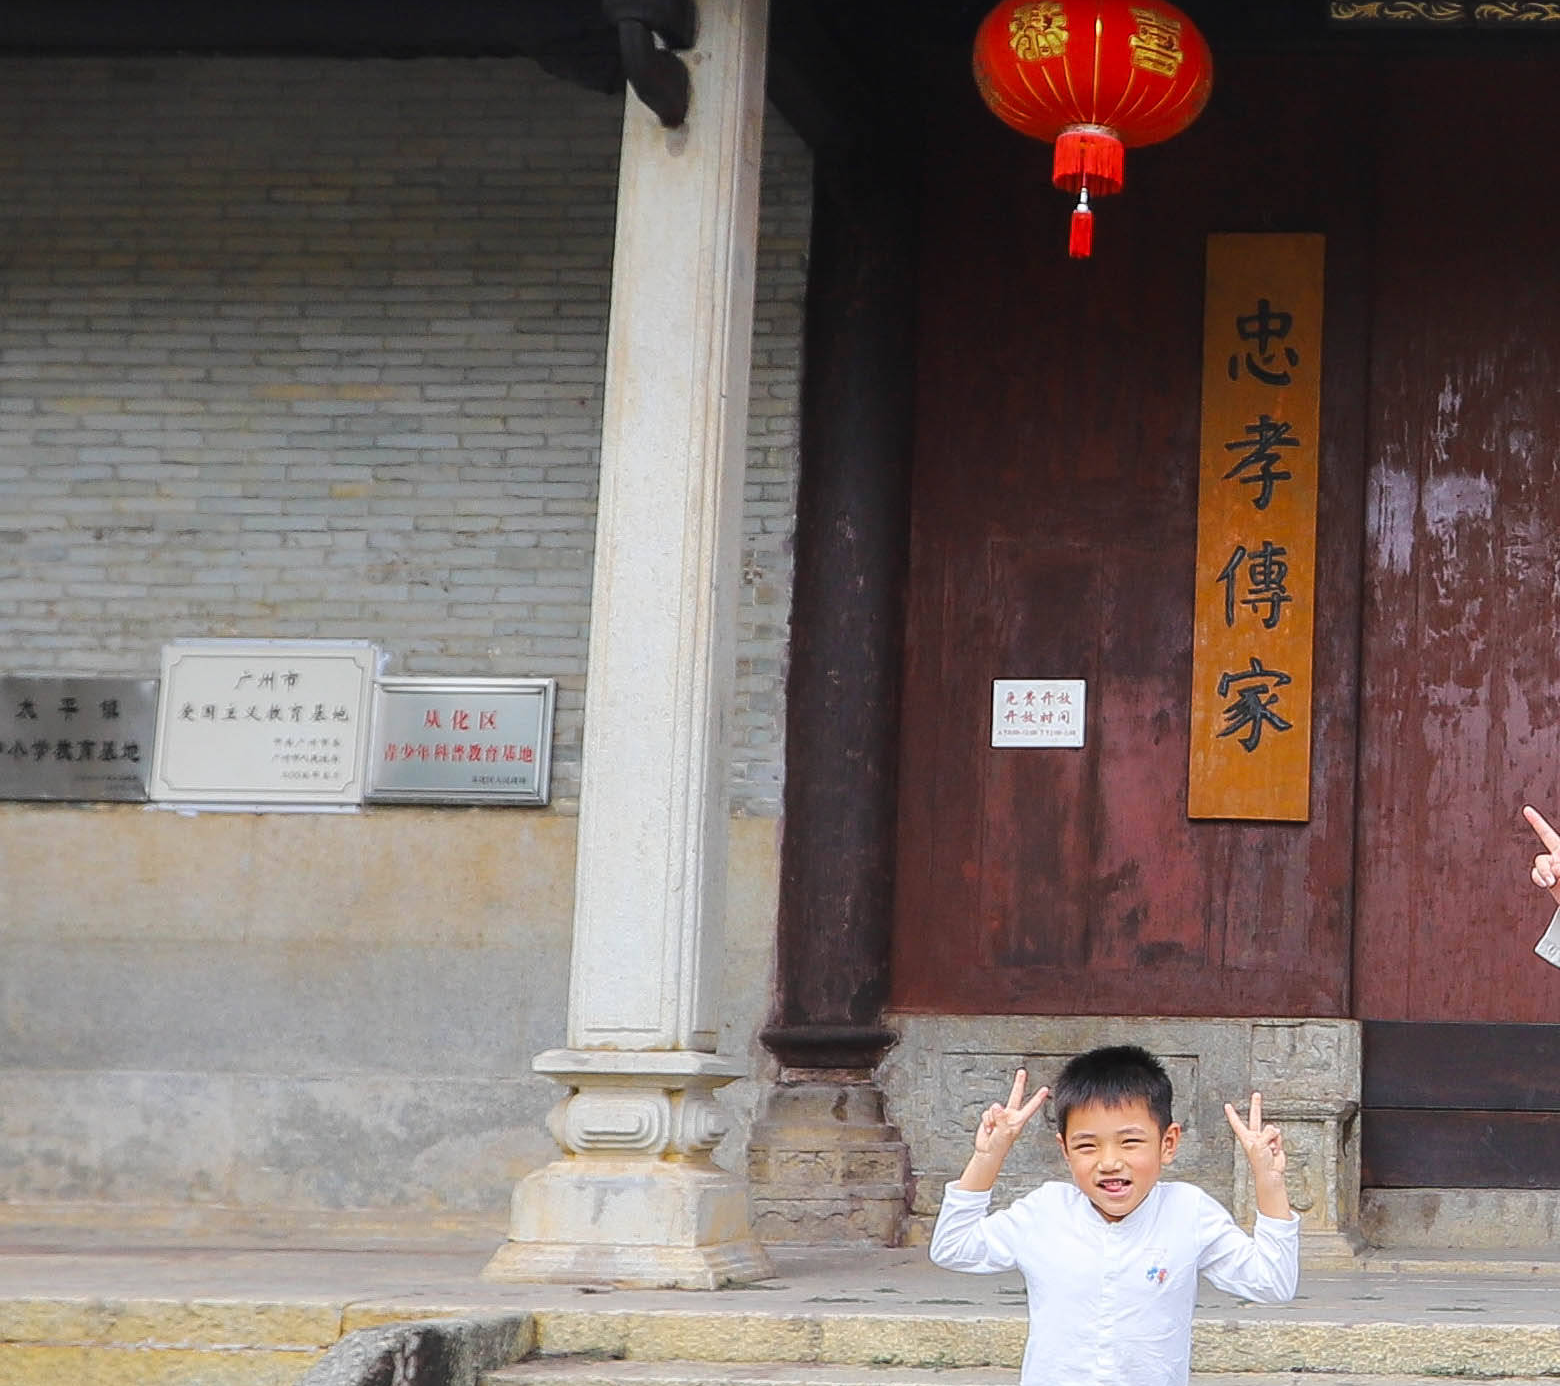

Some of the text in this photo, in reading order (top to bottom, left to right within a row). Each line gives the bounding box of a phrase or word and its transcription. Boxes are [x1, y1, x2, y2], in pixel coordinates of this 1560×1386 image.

[1216, 298, 1300, 752] 忠孝傳家
[234, 669, 299, 692] 广州市
[177, 700, 349, 722] 爱国主义教育基地
[424, 709, 497, 730] 从化区
[384, 744, 534, 763] 青少年科普教育基地
